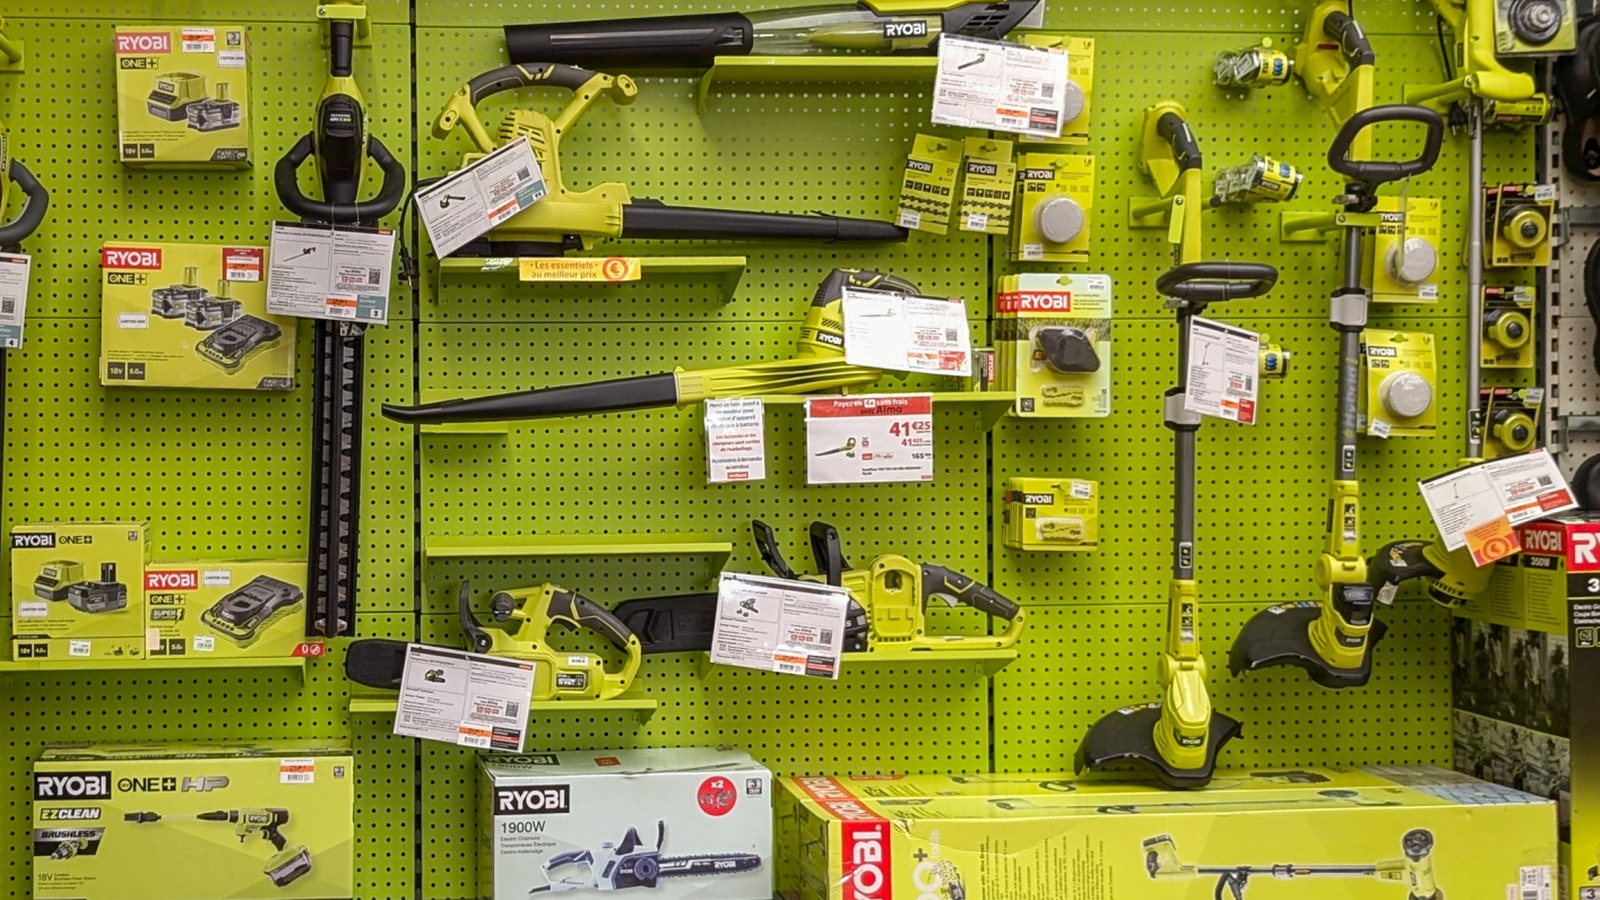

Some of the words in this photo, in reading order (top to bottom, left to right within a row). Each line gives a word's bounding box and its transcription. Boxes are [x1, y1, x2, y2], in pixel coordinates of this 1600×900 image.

[886, 23, 925, 36] RYOBI
[118, 35, 168, 50] RYOBI
[908, 160, 933, 172] RYOBI
[969, 164, 995, 174] RYOBI
[1027, 170, 1053, 180] RYOBI
[106, 250, 159, 267] RYOBI
[535, 261, 549, 269] Les
[551, 261, 593, 270] essentiels
[531, 271, 542, 279] au
[544, 270, 579, 279] meilleur
[580, 270, 597, 279] prix
[1020, 294, 1068, 309] RYOBI
[819, 332, 842, 345] RYOBI
[1369, 347, 1396, 356] RYOBI
[833, 400, 853, 408] Payez
[876, 405, 903, 415] Alma
[1025, 495, 1052, 504] RYOBI
[15, 535, 53, 546] RYOBI
[1525, 528, 1563, 551] RYOBI
[1571, 532, 1600, 564] R
[1530, 556, 1550, 567] 350W
[147, 573, 196, 588] RYOBI
[1573, 610, 1591, 618] Coupe
[301, 645, 308, 654] 0
[1181, 738, 1201, 746] RYOBI
[486, 755, 554, 764] RYOBI
[37, 775, 106, 796] RYOBI
[117, 777, 176, 792] ONE+
[181, 776, 229, 792] HP
[710, 780, 724, 789] x2
[801, 777, 847, 799] RYOBI
[498, 789, 567, 811] RYOBI
[42, 808, 100, 820] EZCLEAN
[501, 821, 546, 834] 1900W
[41, 831, 96, 839] BRUSHLESS
[714, 861, 736, 869] RYOBI
[38, 873, 54, 881] 18V
[1586, 888, 1596, 900] 3
